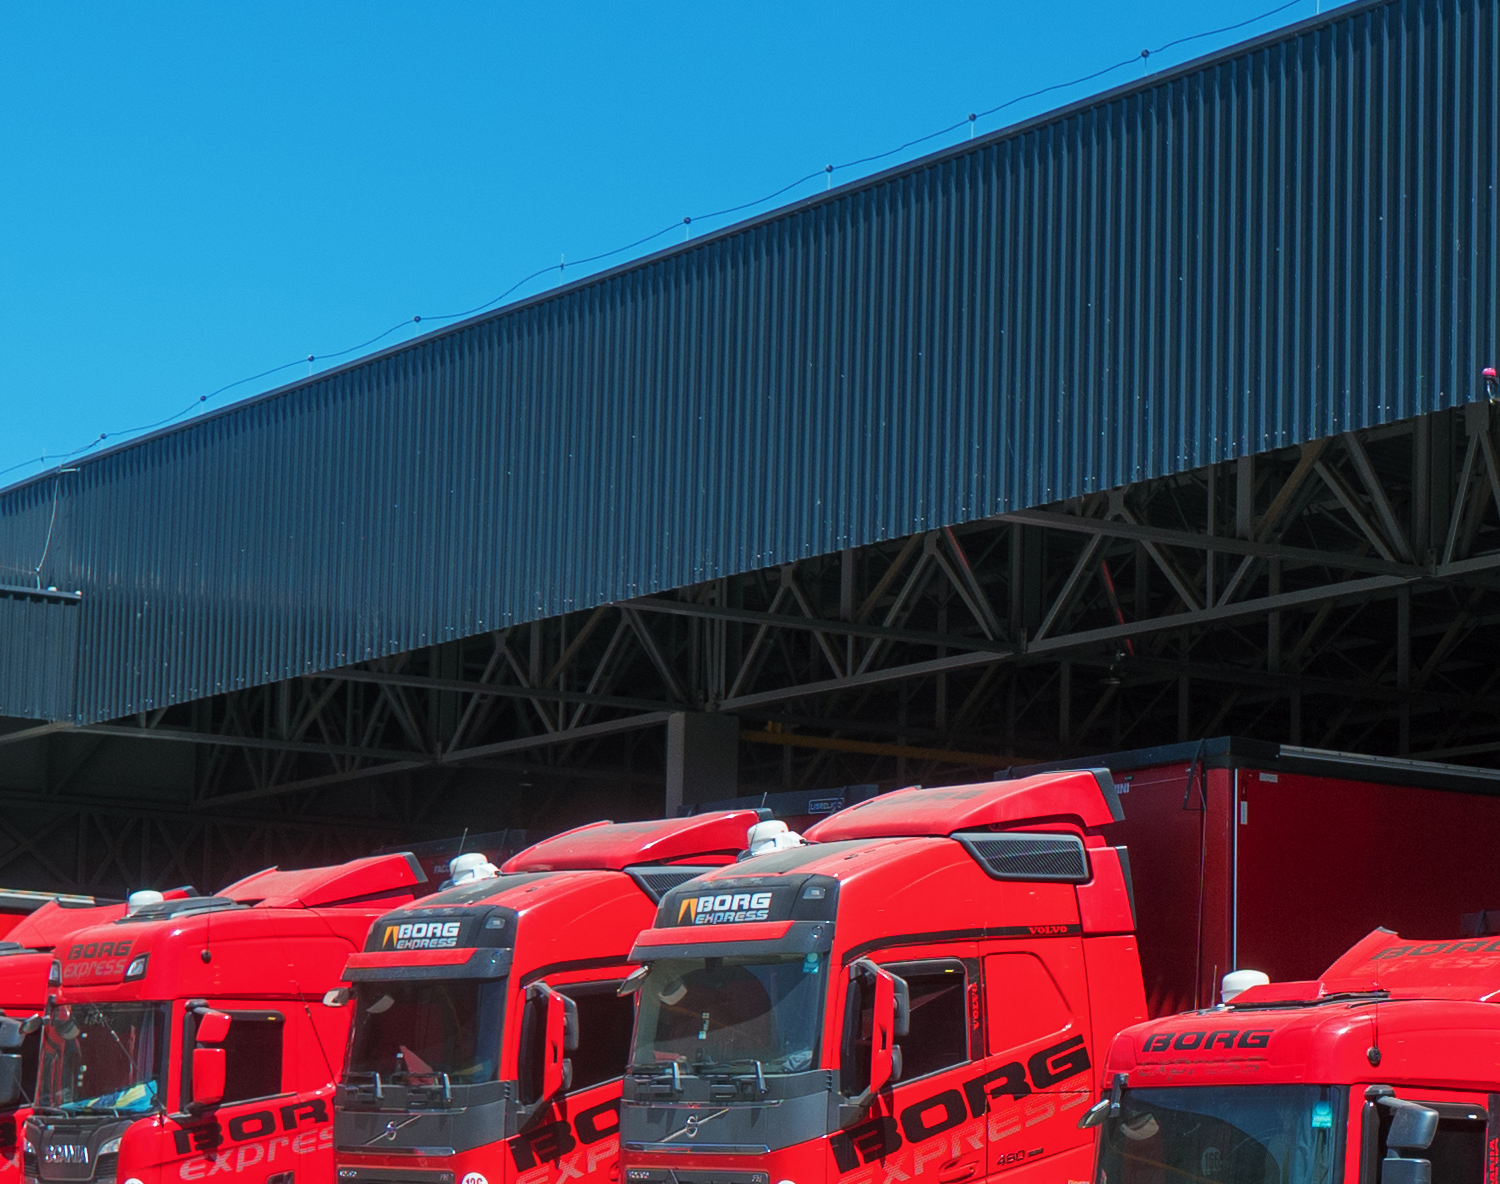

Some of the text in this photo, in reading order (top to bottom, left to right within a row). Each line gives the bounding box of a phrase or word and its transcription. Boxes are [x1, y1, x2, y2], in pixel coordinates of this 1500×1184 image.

[697, 892, 773, 912] BORG
[694, 910, 770, 924] EXPRESS
[398, 922, 461, 939] BORG
[1028, 925, 1068, 934] VOLVO
[68, 940, 134, 960] BORG
[396, 937, 458, 949] EXPRESS
[1142, 1029, 1275, 1053] BORG
[829, 1034, 1092, 1174] BORG
[174, 1096, 334, 1155] BOR
[508, 1096, 620, 1173] BO
[44, 1144, 89, 1164] SCANIA
